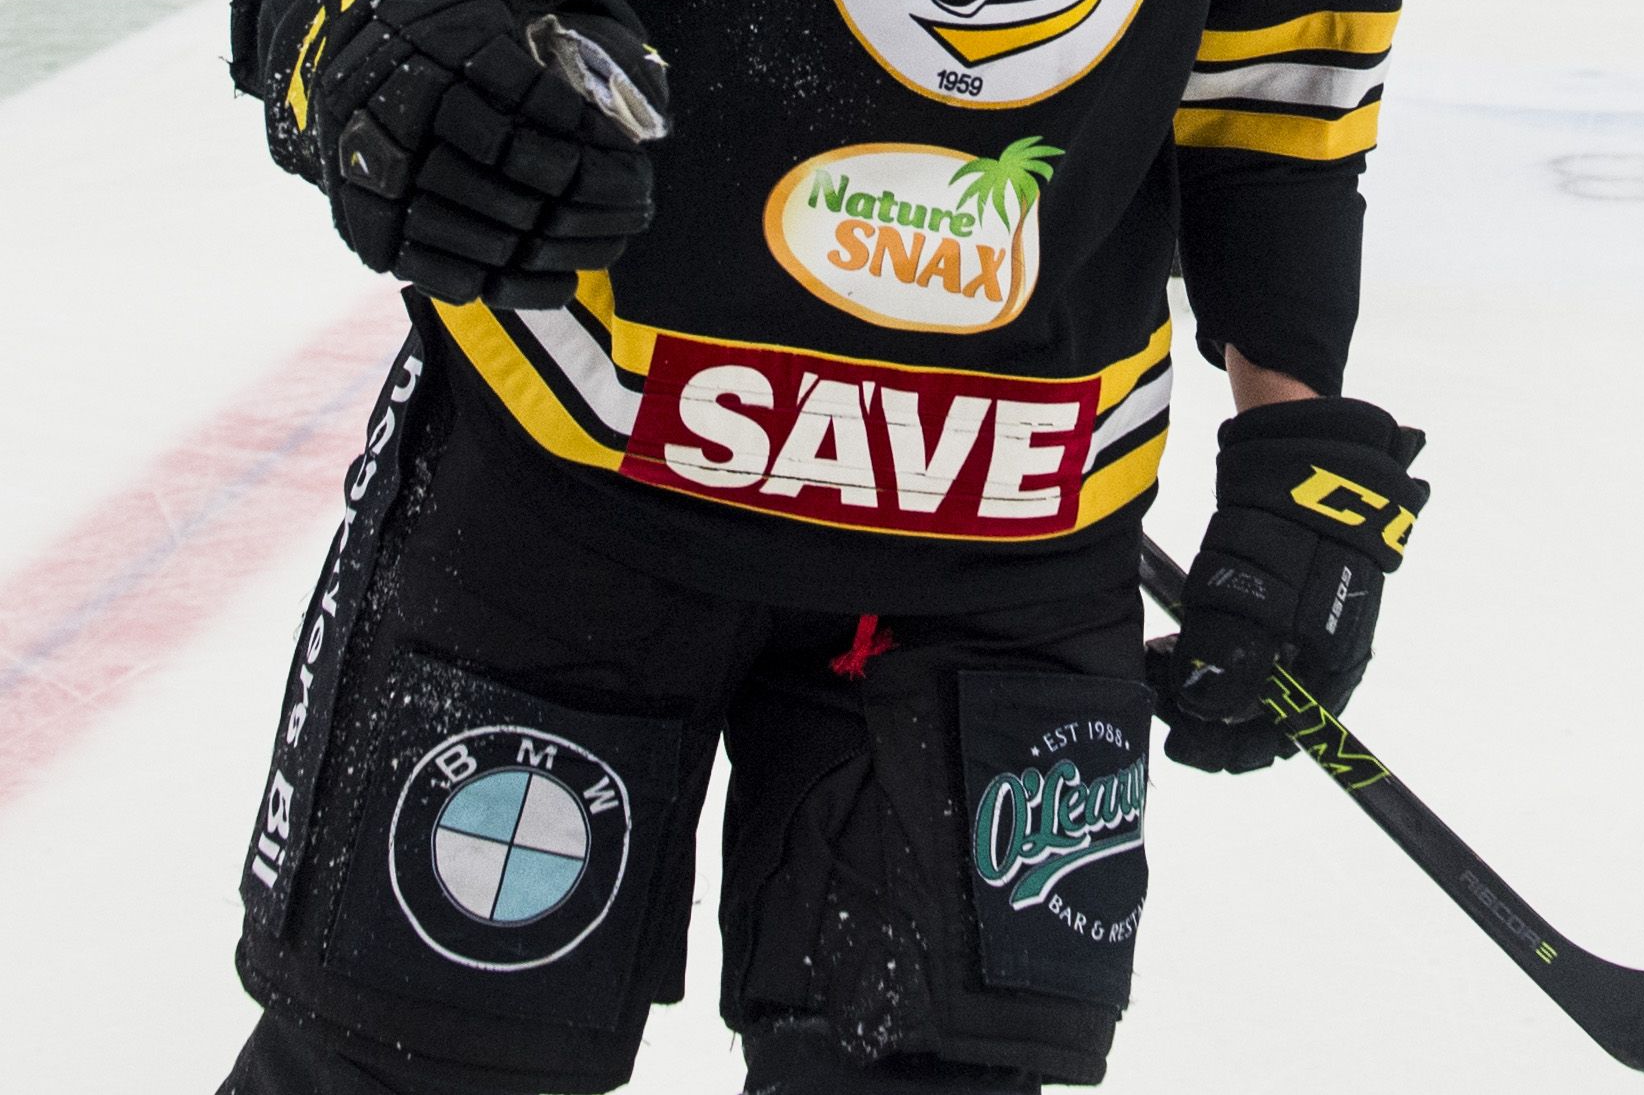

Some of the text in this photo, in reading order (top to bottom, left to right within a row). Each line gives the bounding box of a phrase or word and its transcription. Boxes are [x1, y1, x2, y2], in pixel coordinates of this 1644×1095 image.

[936, 68, 984, 97] 1959
[807, 168, 976, 238] Nature
[827, 219, 1006, 303] SNAX
[663, 365, 1080, 520] SÄVE
[1043, 722, 1079, 752] EST
[435, 738, 619, 815] BMW
[252, 769, 295, 889] Bil
[1048, 894, 1084, 935] BAR
[1091, 920, 1105, 941] &
